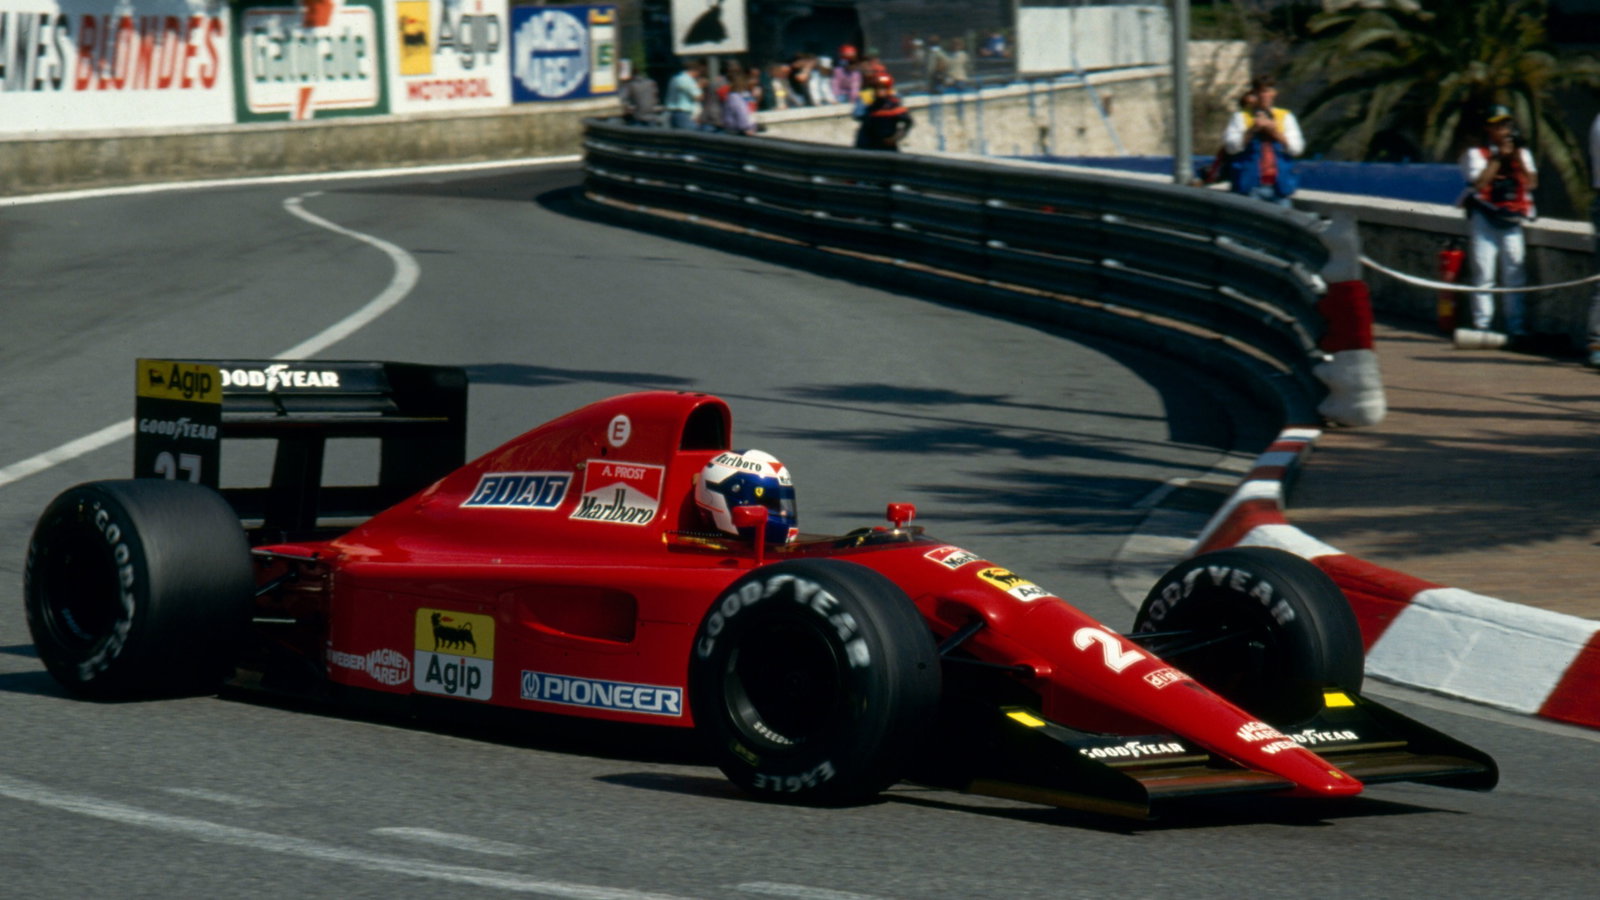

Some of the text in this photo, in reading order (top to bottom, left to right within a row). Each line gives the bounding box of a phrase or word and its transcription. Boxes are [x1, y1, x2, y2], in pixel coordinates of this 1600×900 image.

[74, 14, 224, 91] BLONDES
[168, 364, 212, 398] Agip
[612, 421, 626, 441] E
[602, 465, 647, 480] A. PROST
[474, 480, 564, 504] FIAT
[573, 488, 654, 524] Marlboro
[425, 654, 482, 696] Agip
[544, 677, 680, 713] PIONEER
